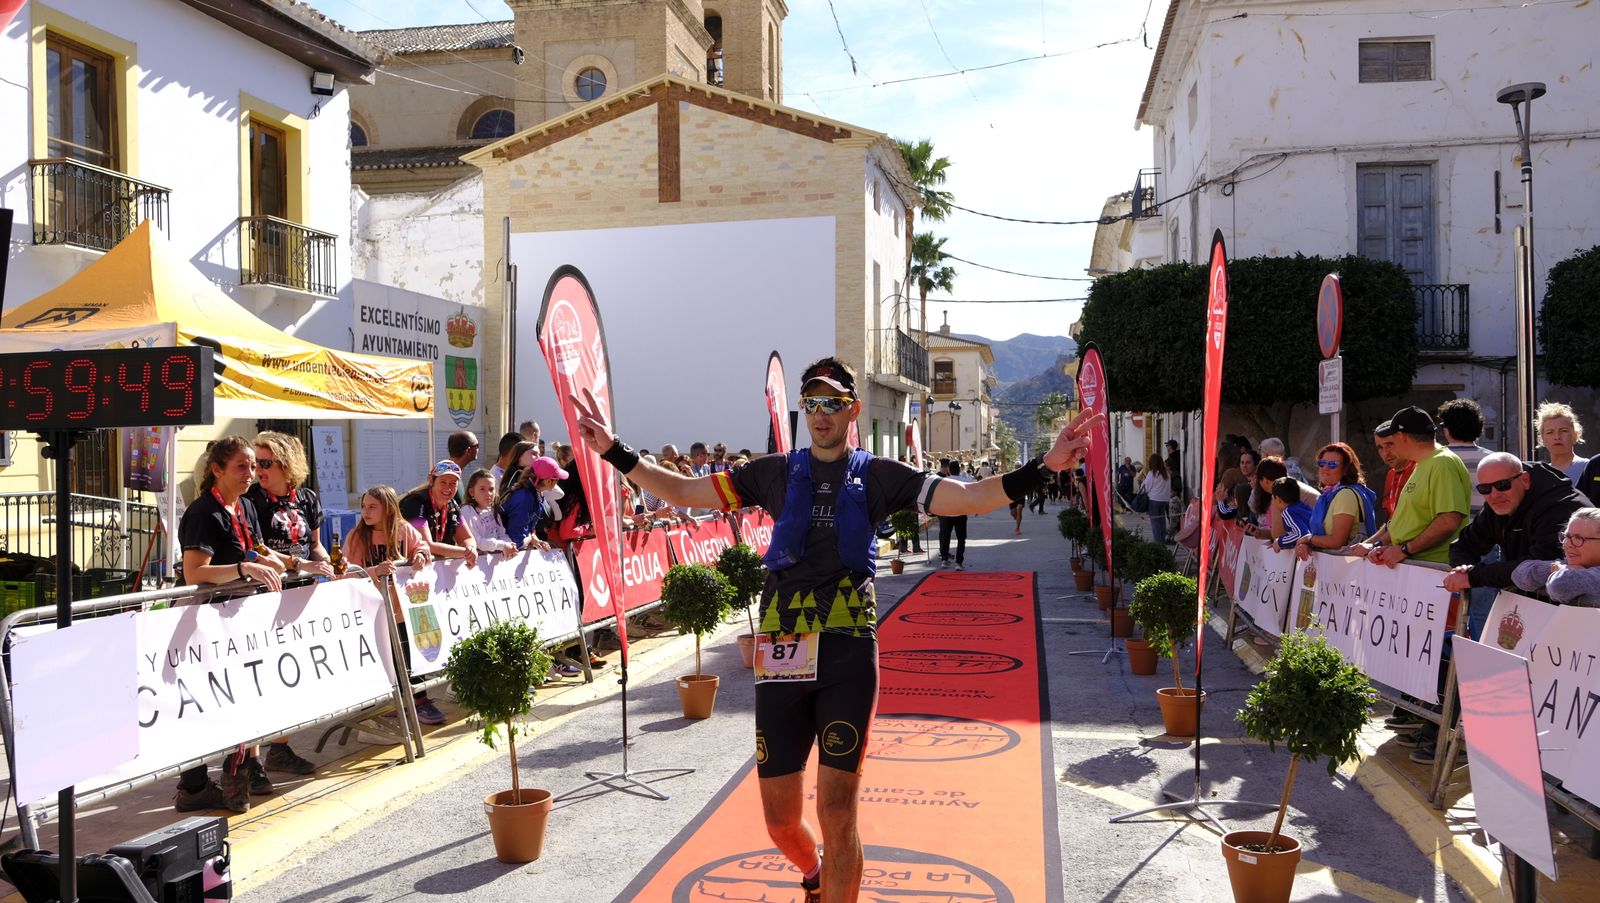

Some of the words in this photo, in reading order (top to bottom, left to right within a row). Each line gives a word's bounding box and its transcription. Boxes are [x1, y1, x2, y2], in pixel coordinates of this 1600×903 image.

[360, 305, 441, 336] EXCELENTÍSIMO
[362, 333, 439, 361] AYUNTAMIENTO
[0, 355, 196, 421] :59:49
[624, 551, 664, 587] EOLIA
[445, 572, 544, 601] AYUNTAMIENTO
[549, 569, 564, 583] DE
[447, 586, 572, 636] CANTORIA
[1414, 600, 1435, 622] DE
[137, 616, 332, 676] YUNTAMIENTO
[341, 609, 364, 630] DE
[1318, 600, 1433, 666] CANTORIA
[771, 642, 798, 661] 87
[137, 634, 377, 728] CANTORIA
[873, 721, 955, 732] POLVO
[933, 790, 966, 798] de
[926, 871, 972, 884] LA
